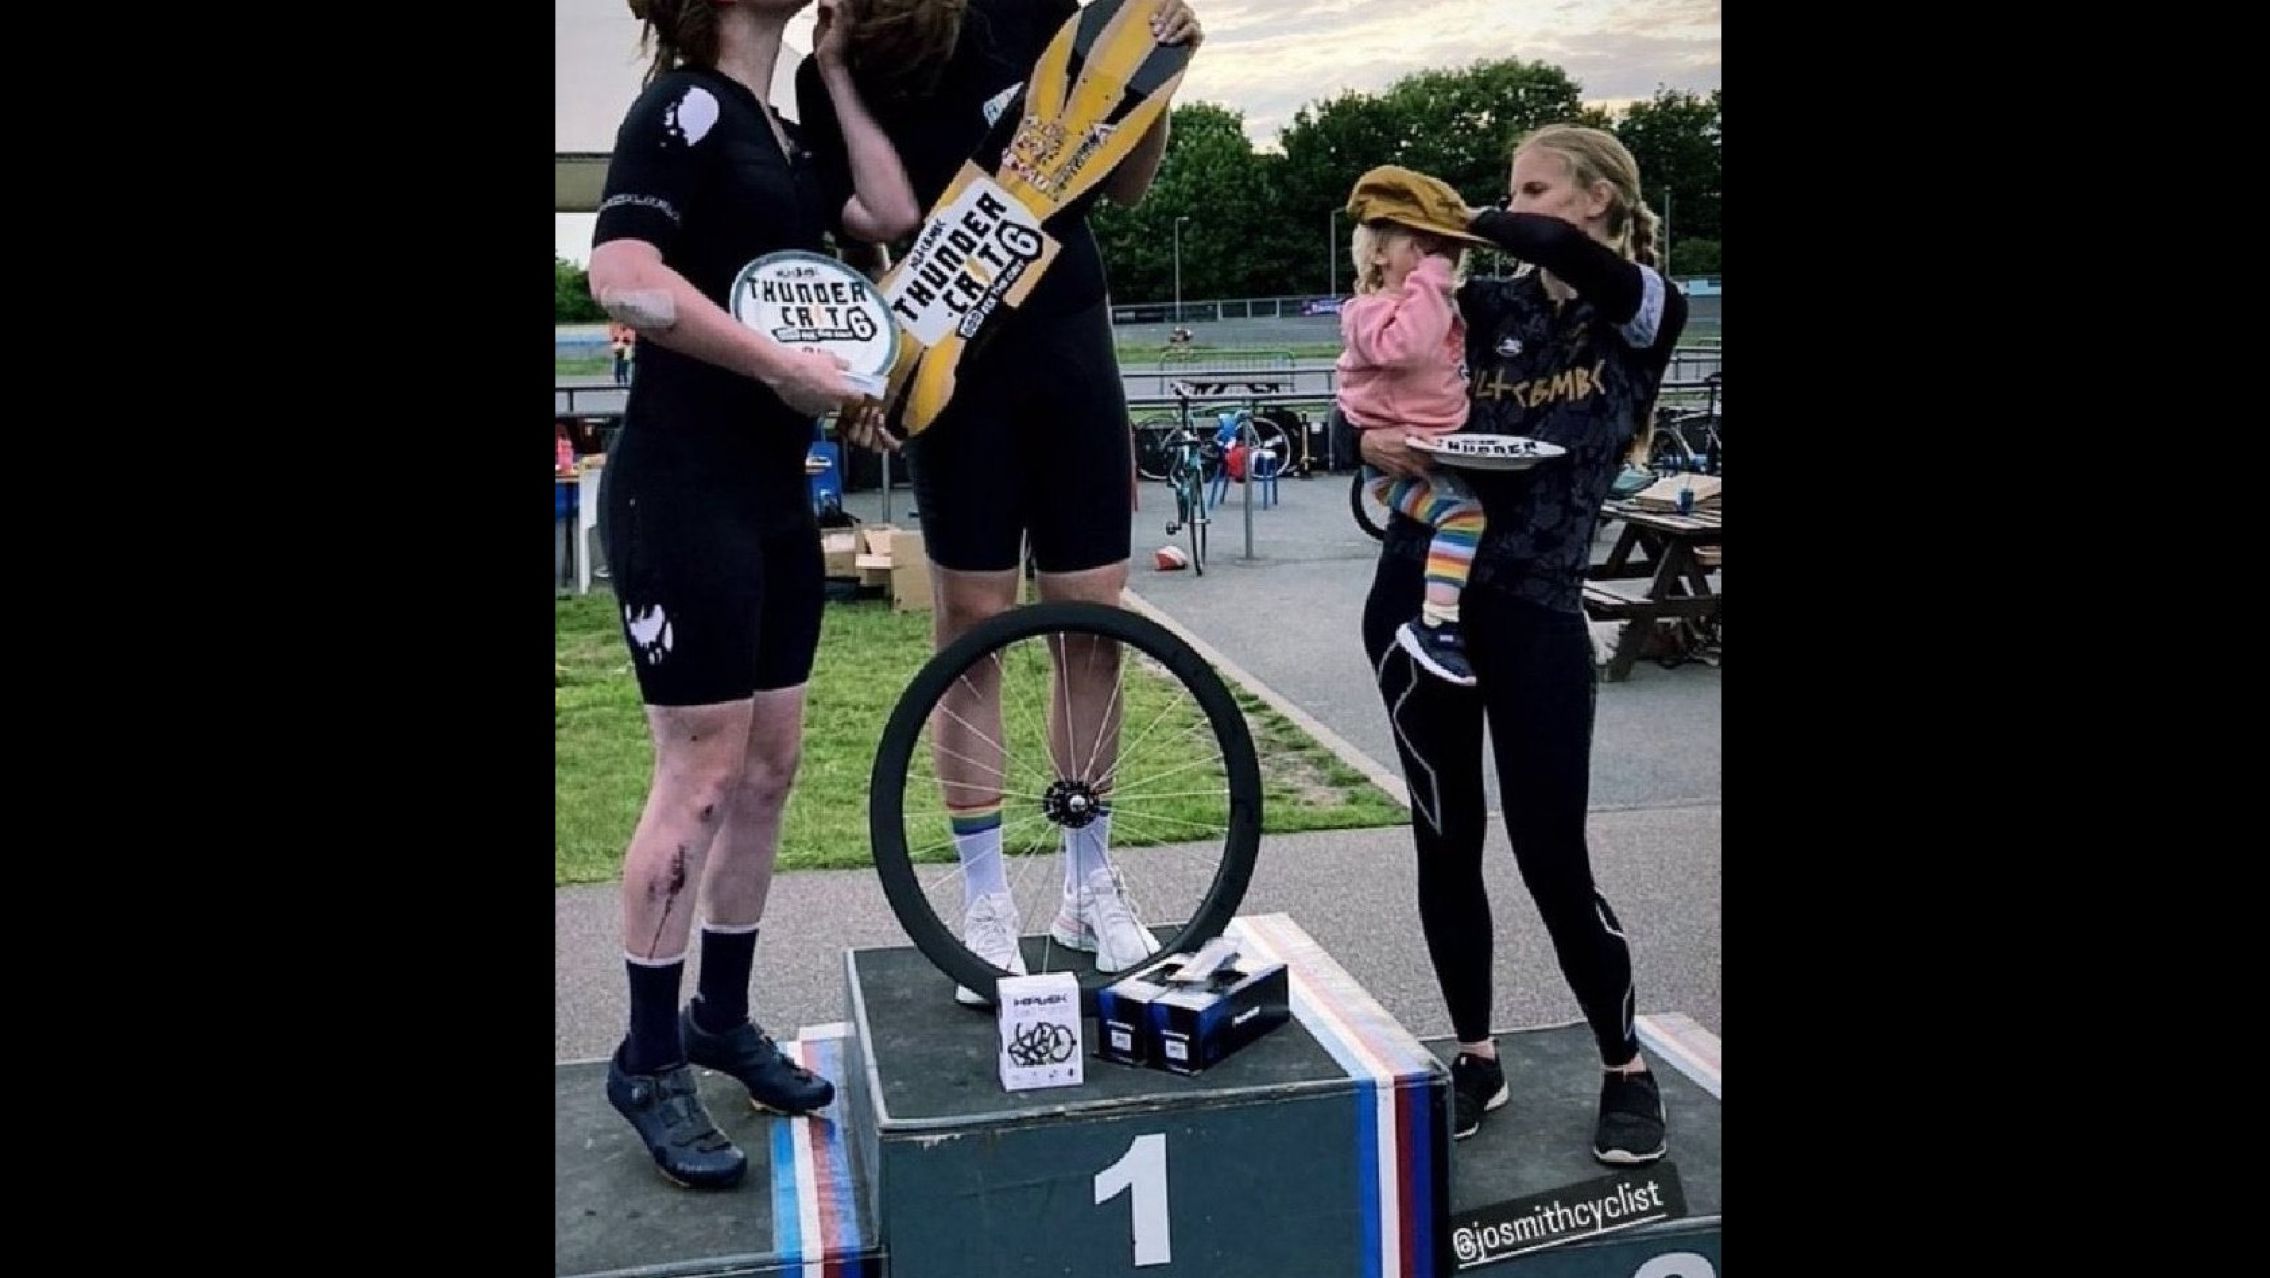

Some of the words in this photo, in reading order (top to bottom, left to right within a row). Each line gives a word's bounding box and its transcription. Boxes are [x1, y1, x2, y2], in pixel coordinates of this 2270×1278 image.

[892, 190, 1007, 322] THUNDER
[994, 219, 1044, 262] 6
[746, 276, 868, 305] THUNDER
[847, 305, 878, 342] 6
[1094, 1132, 1171, 1267] 1
